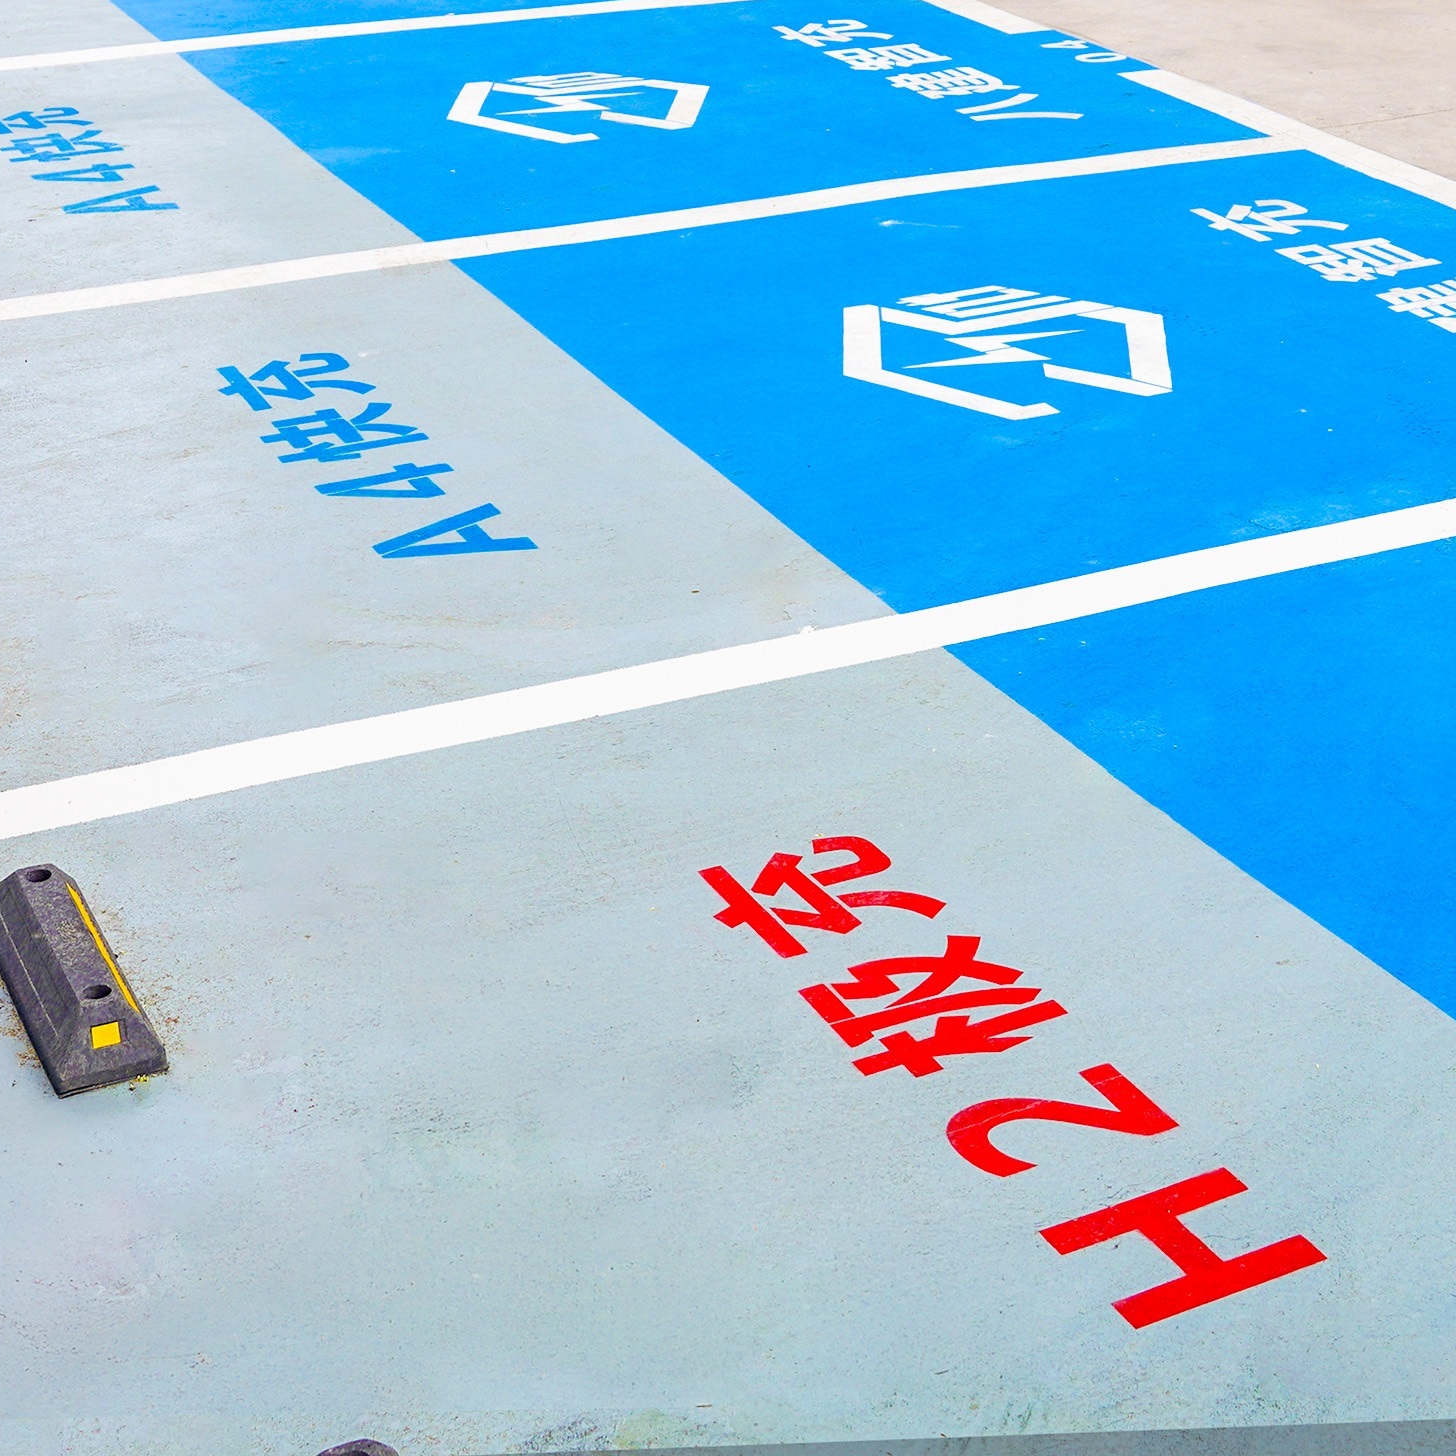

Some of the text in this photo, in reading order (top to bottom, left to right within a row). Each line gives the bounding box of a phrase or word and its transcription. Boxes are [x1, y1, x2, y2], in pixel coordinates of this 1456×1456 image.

[771, 18, 1084, 122] 八建智充
[1041, 38, 1128, 63] 04
[215, 352, 540, 560] A4快充
[697, 834, 1328, 1331] H2极充
